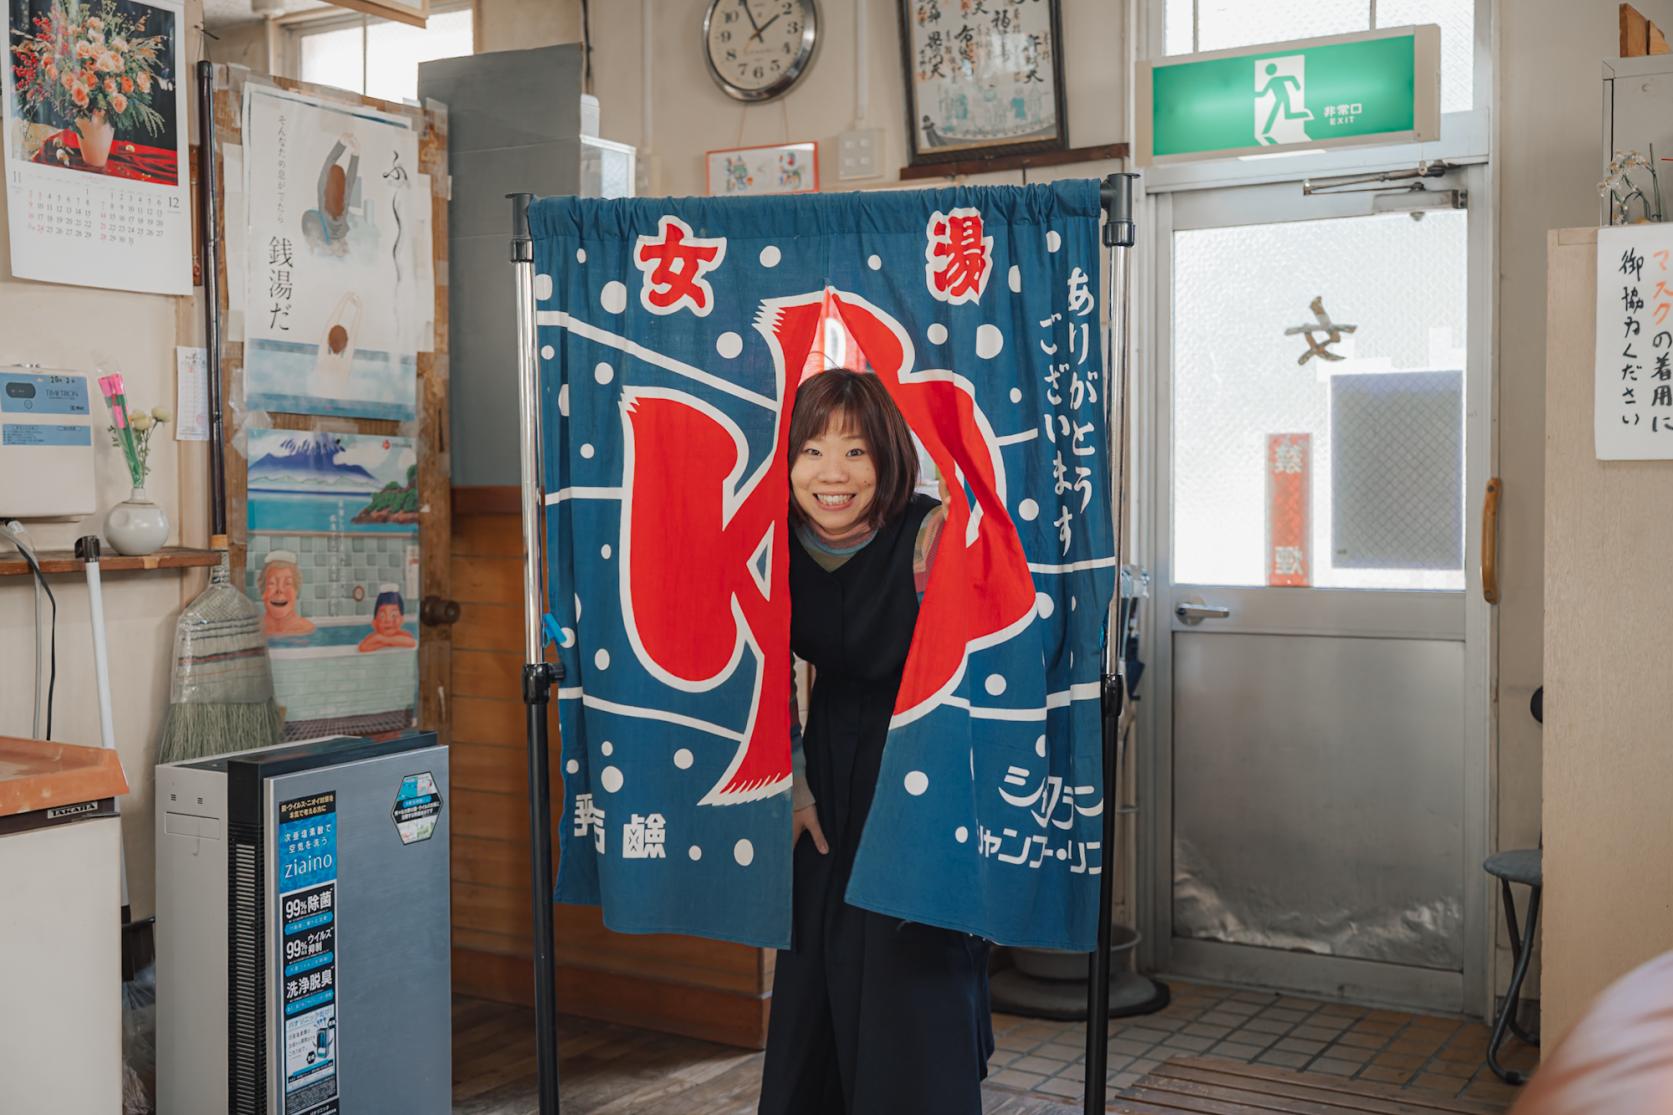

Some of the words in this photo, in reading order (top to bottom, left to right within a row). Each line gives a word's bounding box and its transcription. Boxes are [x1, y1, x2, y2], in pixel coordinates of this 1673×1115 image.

[787, 21, 799, 34] 3
[737, 63, 748, 76] 7
[753, 65, 764, 79] 6
[1323, 103, 1362, 117] 非常口
[1330, 116, 1355, 126] EXIT
[168, 196, 180, 209] 12
[634, 215, 727, 317] 女
[925, 207, 993, 305] 湯
[269, 235, 294, 331] 銭湯だ
[1618, 247, 1645, 426] 御協力ください
[1651, 250, 1673, 433] マスクの着用に
[1066, 266, 1098, 514] ありがとう
[1039, 311, 1073, 557] ございます
[284, 853, 333, 879] ziaino
[307, 889, 332, 913] 除菌
[308, 928, 333, 944] ウイルス
[286, 969, 333, 999] 洗浄脱臭
